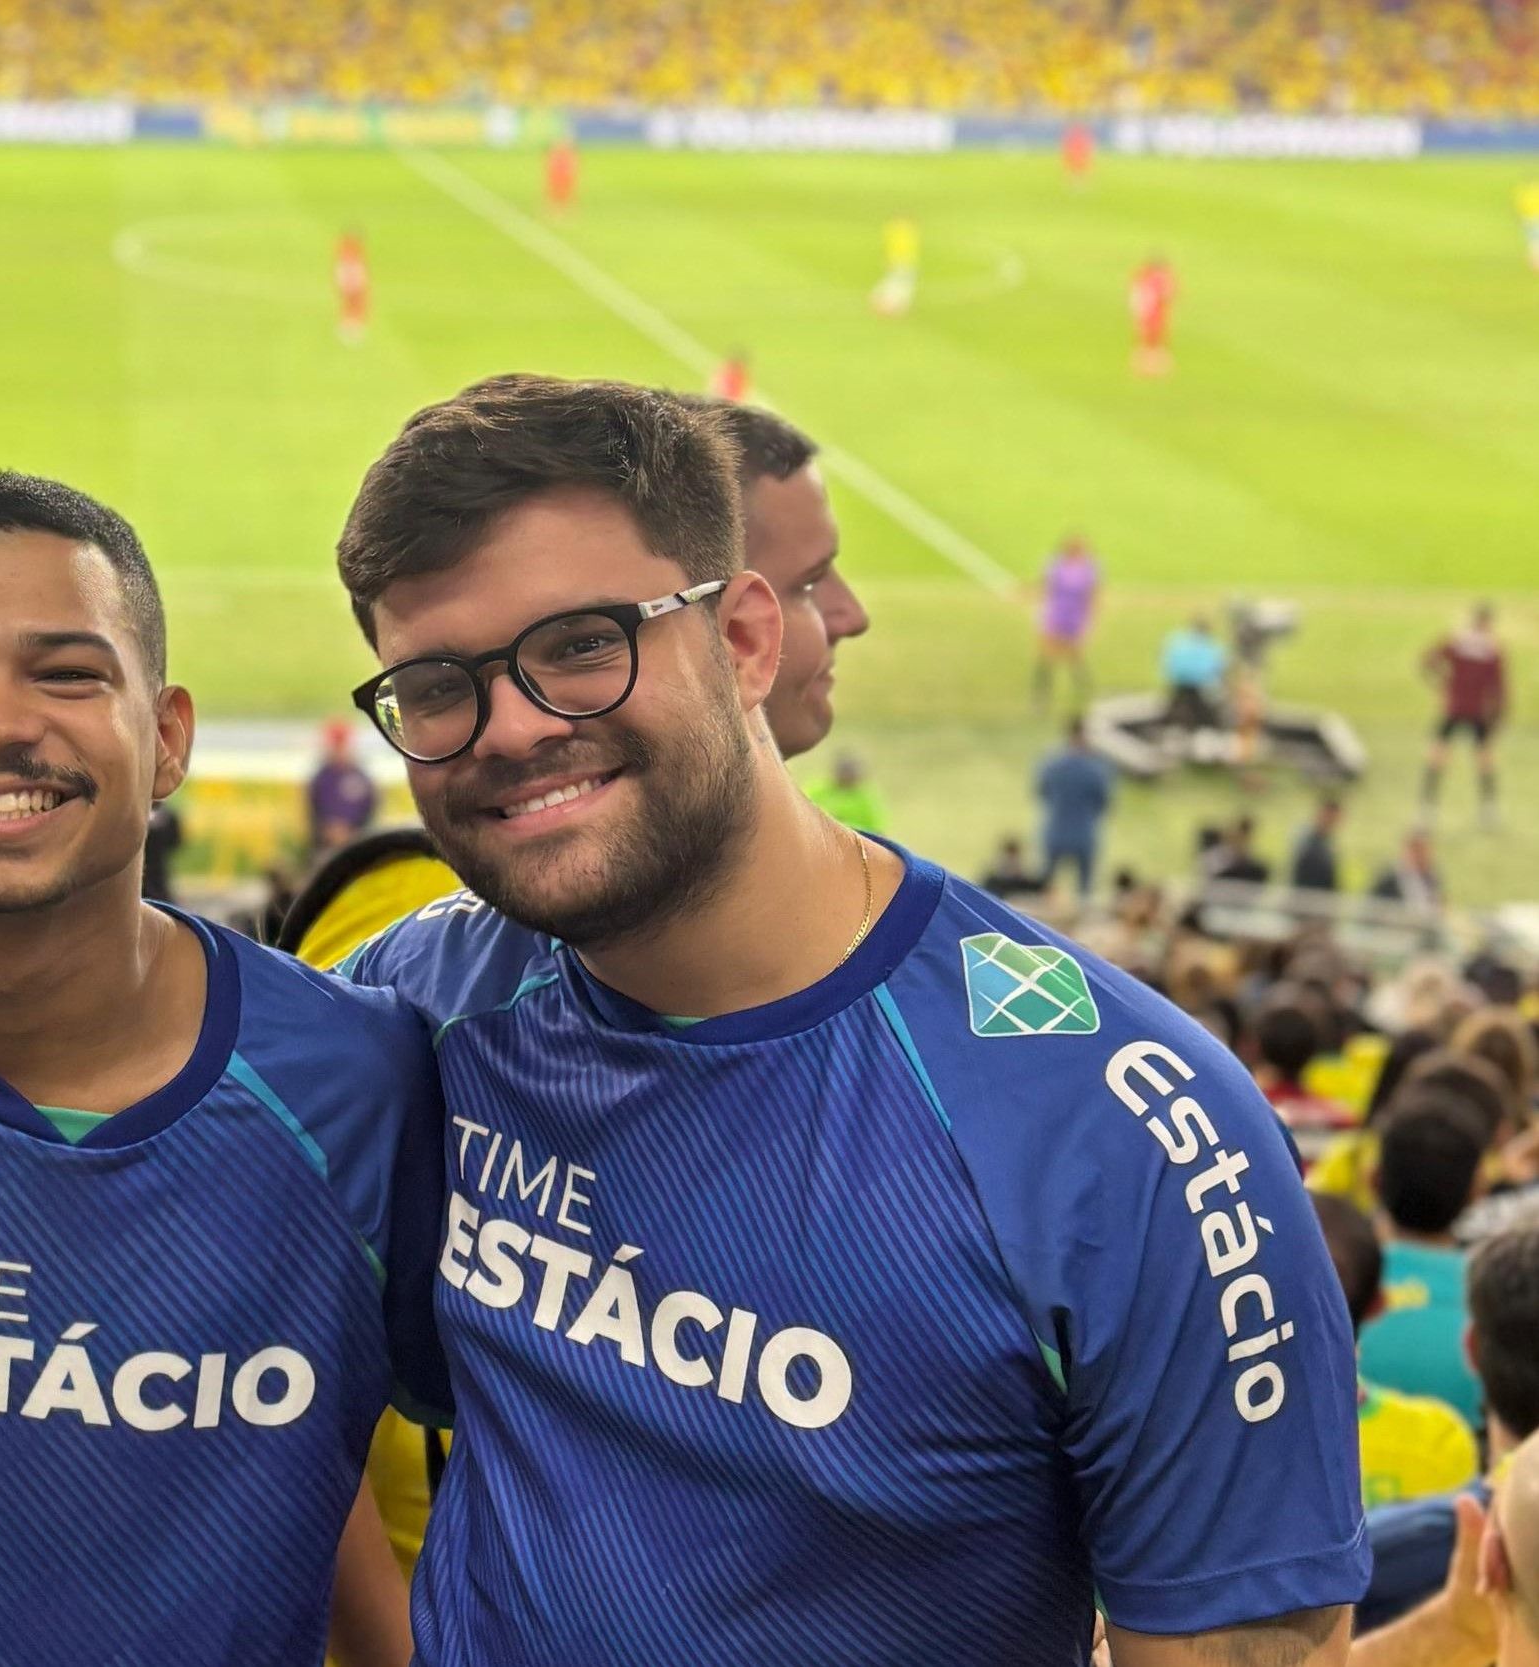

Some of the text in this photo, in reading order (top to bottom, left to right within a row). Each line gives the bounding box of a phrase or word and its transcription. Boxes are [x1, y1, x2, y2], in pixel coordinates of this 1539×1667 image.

[452, 1115, 597, 1236] TIME
[1104, 1039, 1295, 1424] Estácio
[438, 1190, 853, 1430] ESTÁCIO
